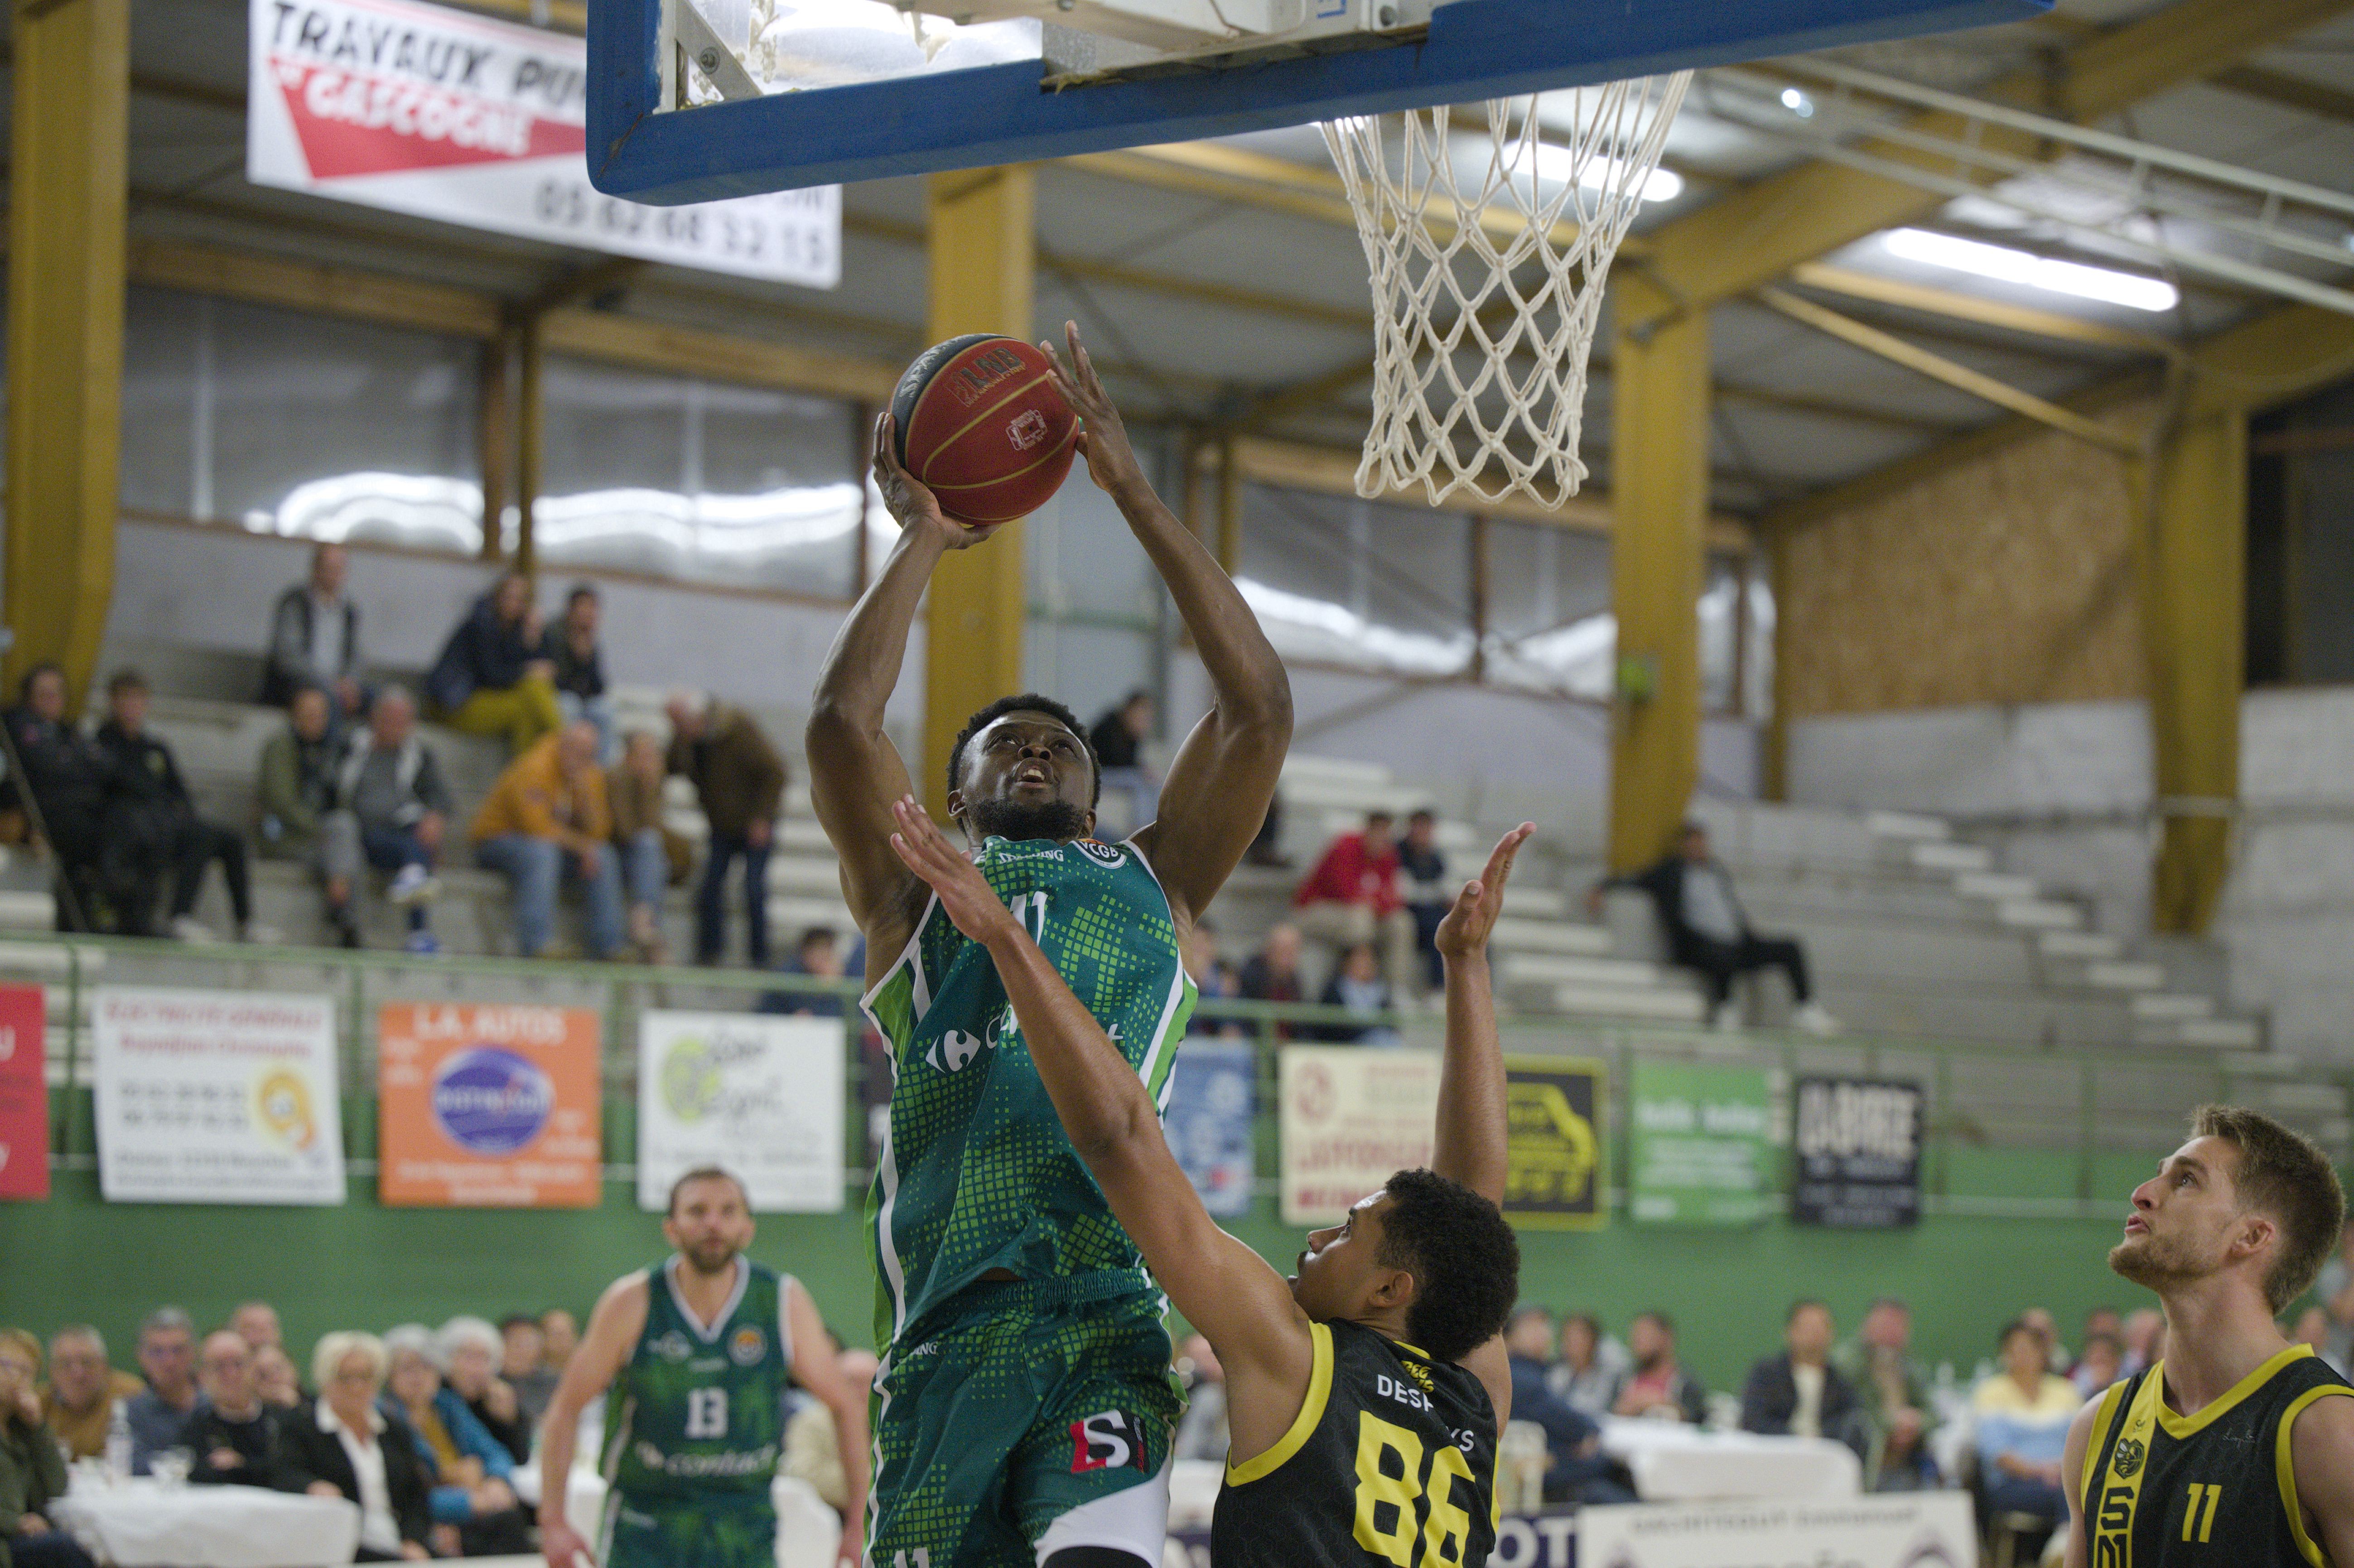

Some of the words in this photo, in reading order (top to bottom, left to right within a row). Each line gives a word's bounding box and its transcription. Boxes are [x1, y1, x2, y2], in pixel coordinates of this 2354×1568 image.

[271, 2, 489, 87] TRAVAUX
[514, 57, 587, 106] PU
[304, 70, 531, 157] GASCOGNE
[686, 1387, 728, 1439] 13
[1353, 1410, 1476, 1568] 86
[2181, 1482, 2222, 1544] 11
